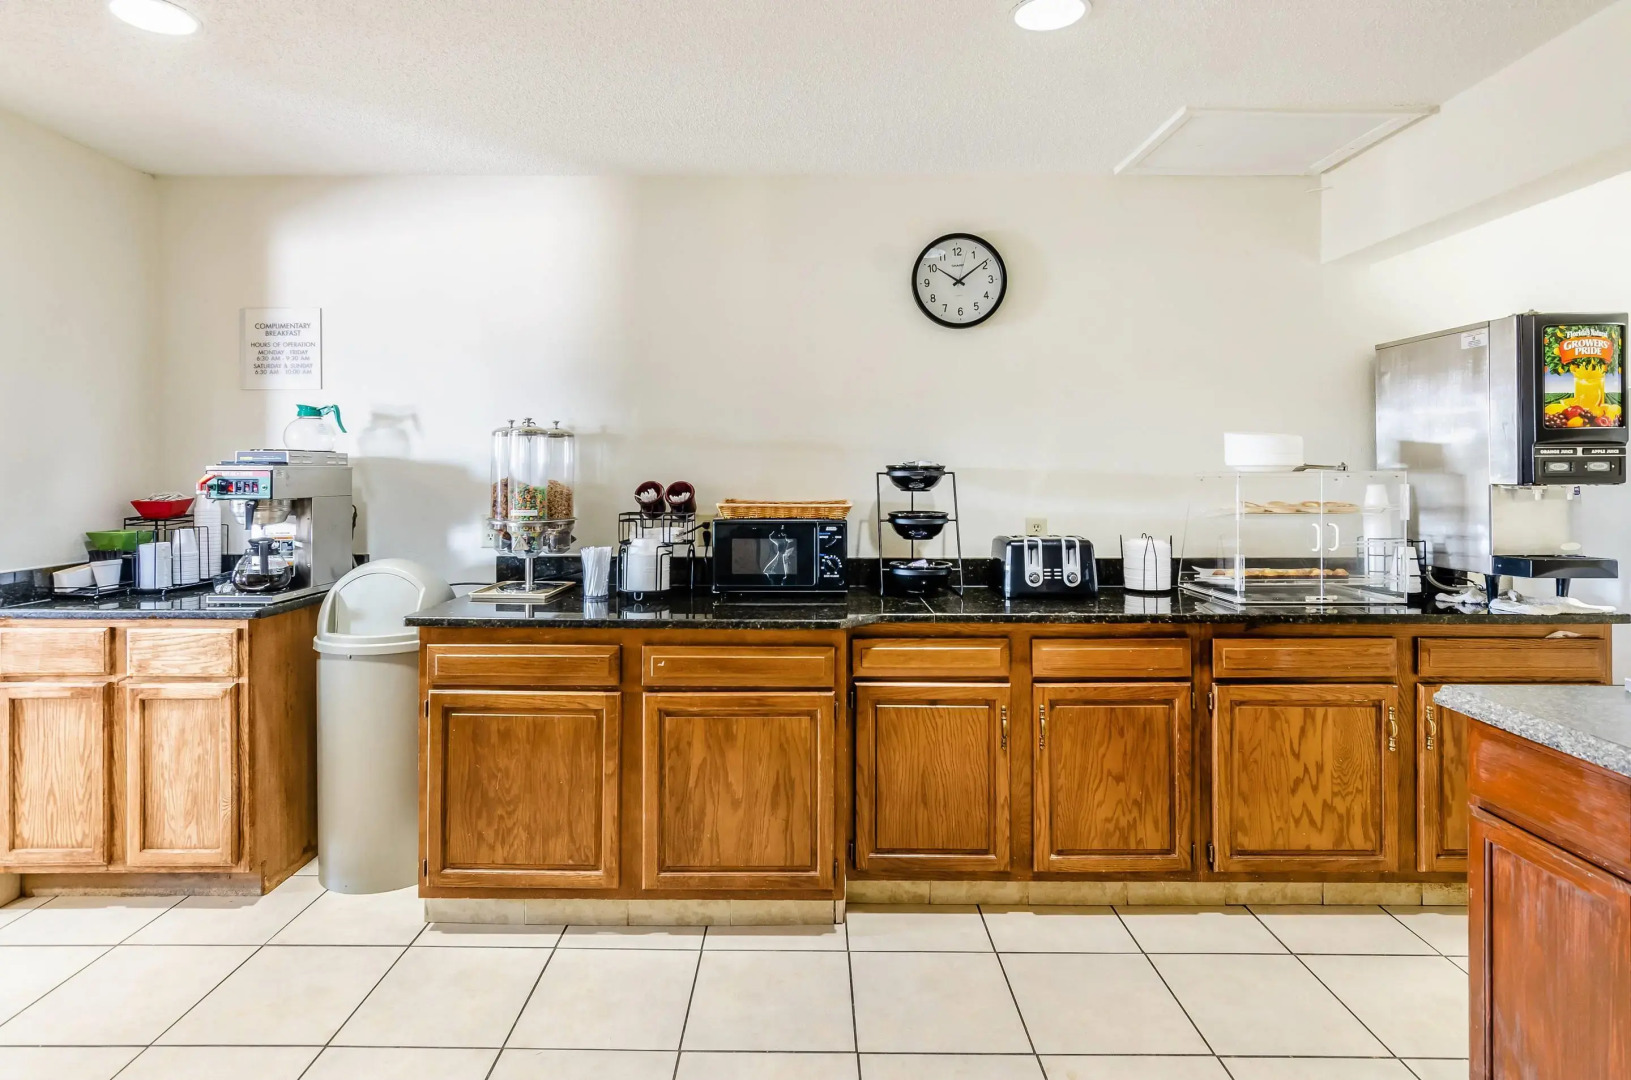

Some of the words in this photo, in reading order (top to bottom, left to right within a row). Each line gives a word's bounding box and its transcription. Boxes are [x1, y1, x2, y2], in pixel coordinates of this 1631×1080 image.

[952, 248, 962, 256] 12
[972, 250, 976, 259] 1
[928, 264, 937, 273] 10
[982, 260, 988, 270] 2
[924, 279, 930, 287] 9
[988, 275, 994, 283] 3
[930, 294, 936, 303] 8
[984, 291, 989, 299] 4
[942, 304, 948, 312] 7
[973, 302, 979, 310] 5
[957, 307, 964, 316] 6
[1575, 347, 1602, 355] PRIDE
